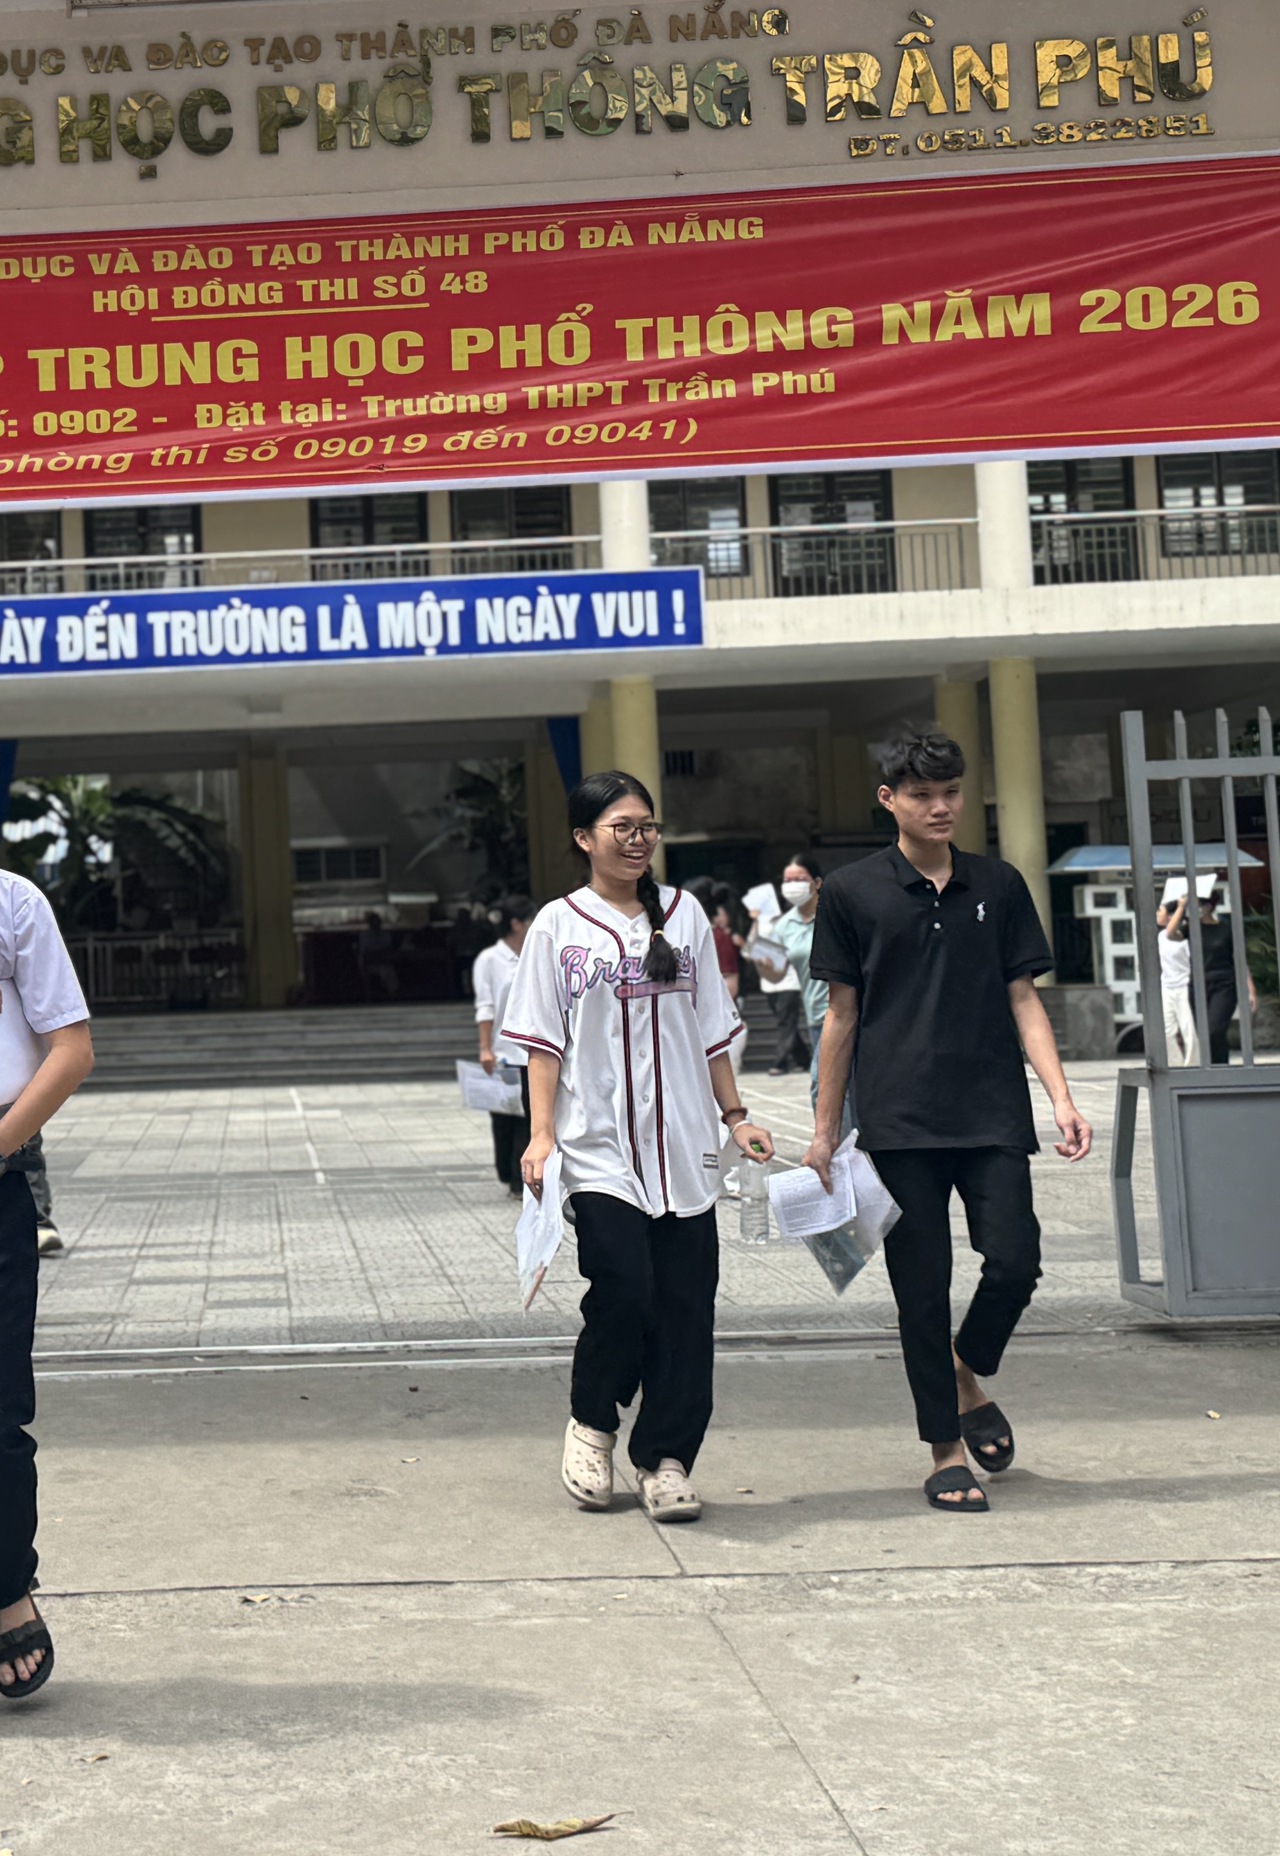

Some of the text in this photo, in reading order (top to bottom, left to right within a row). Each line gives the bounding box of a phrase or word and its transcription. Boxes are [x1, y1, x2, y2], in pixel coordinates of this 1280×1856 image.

[243, 34, 323, 72] TẠO
[335, 20, 476, 62] THÀNH
[491, 9, 582, 53] PHỐ
[594, 9, 652, 46] ĐÀ
[57, 87, 234, 180] HỌC
[256, 54, 434, 155] PHỔ
[457, 50, 753, 144] THÔNG
[770, 8, 1010, 125] TRẦN
[1034, 7, 1216, 109] PHÚ
[88, 247, 140, 275] VÀ
[151, 244, 234, 273] ĐÀO
[246, 242, 322, 270] TẠO
[336, 232, 471, 262] THÀNH
[484, 220, 566, 255] PHỐ
[578, 219, 635, 250] ĐÀ
[647, 213, 765, 245] NẴNG
[93, 266, 489, 317] HỘI ĐỒNG THI SỐ 48
[27, 338, 260, 393] TRUNG
[285, 330, 426, 387] HỌC
[450, 302, 595, 372] PHỔ
[615, 303, 855, 362] THÔNG
[881, 288, 1053, 346] NĂM
[1079, 280, 1261, 335] 2026
[32, 406, 139, 437] 0902
[152, 416, 168, 424] -
[194, 401, 267, 433] Đặt
[279, 396, 347, 428] tại:
[361, 389, 508, 420] Trường
[522, 380, 630, 410] THPT
[642, 371, 738, 404] Trần
[752, 368, 837, 397] Phú
[150, 443, 210, 467] thi
[222, 436, 289, 463] số
[293, 431, 429, 460] 09019
[443, 426, 528, 453] đến
[545, 417, 700, 447] 09041)
[55, 599, 139, 663] ĐẾN
[146, 596, 308, 657] TRƯỜNG
[317, 593, 369, 652] LÀ
[376, 590, 466, 656] MỘT
[475, 584, 582, 646] NGÀY
[589, 589, 660, 639] VUI
[672, 588, 687, 636] !
